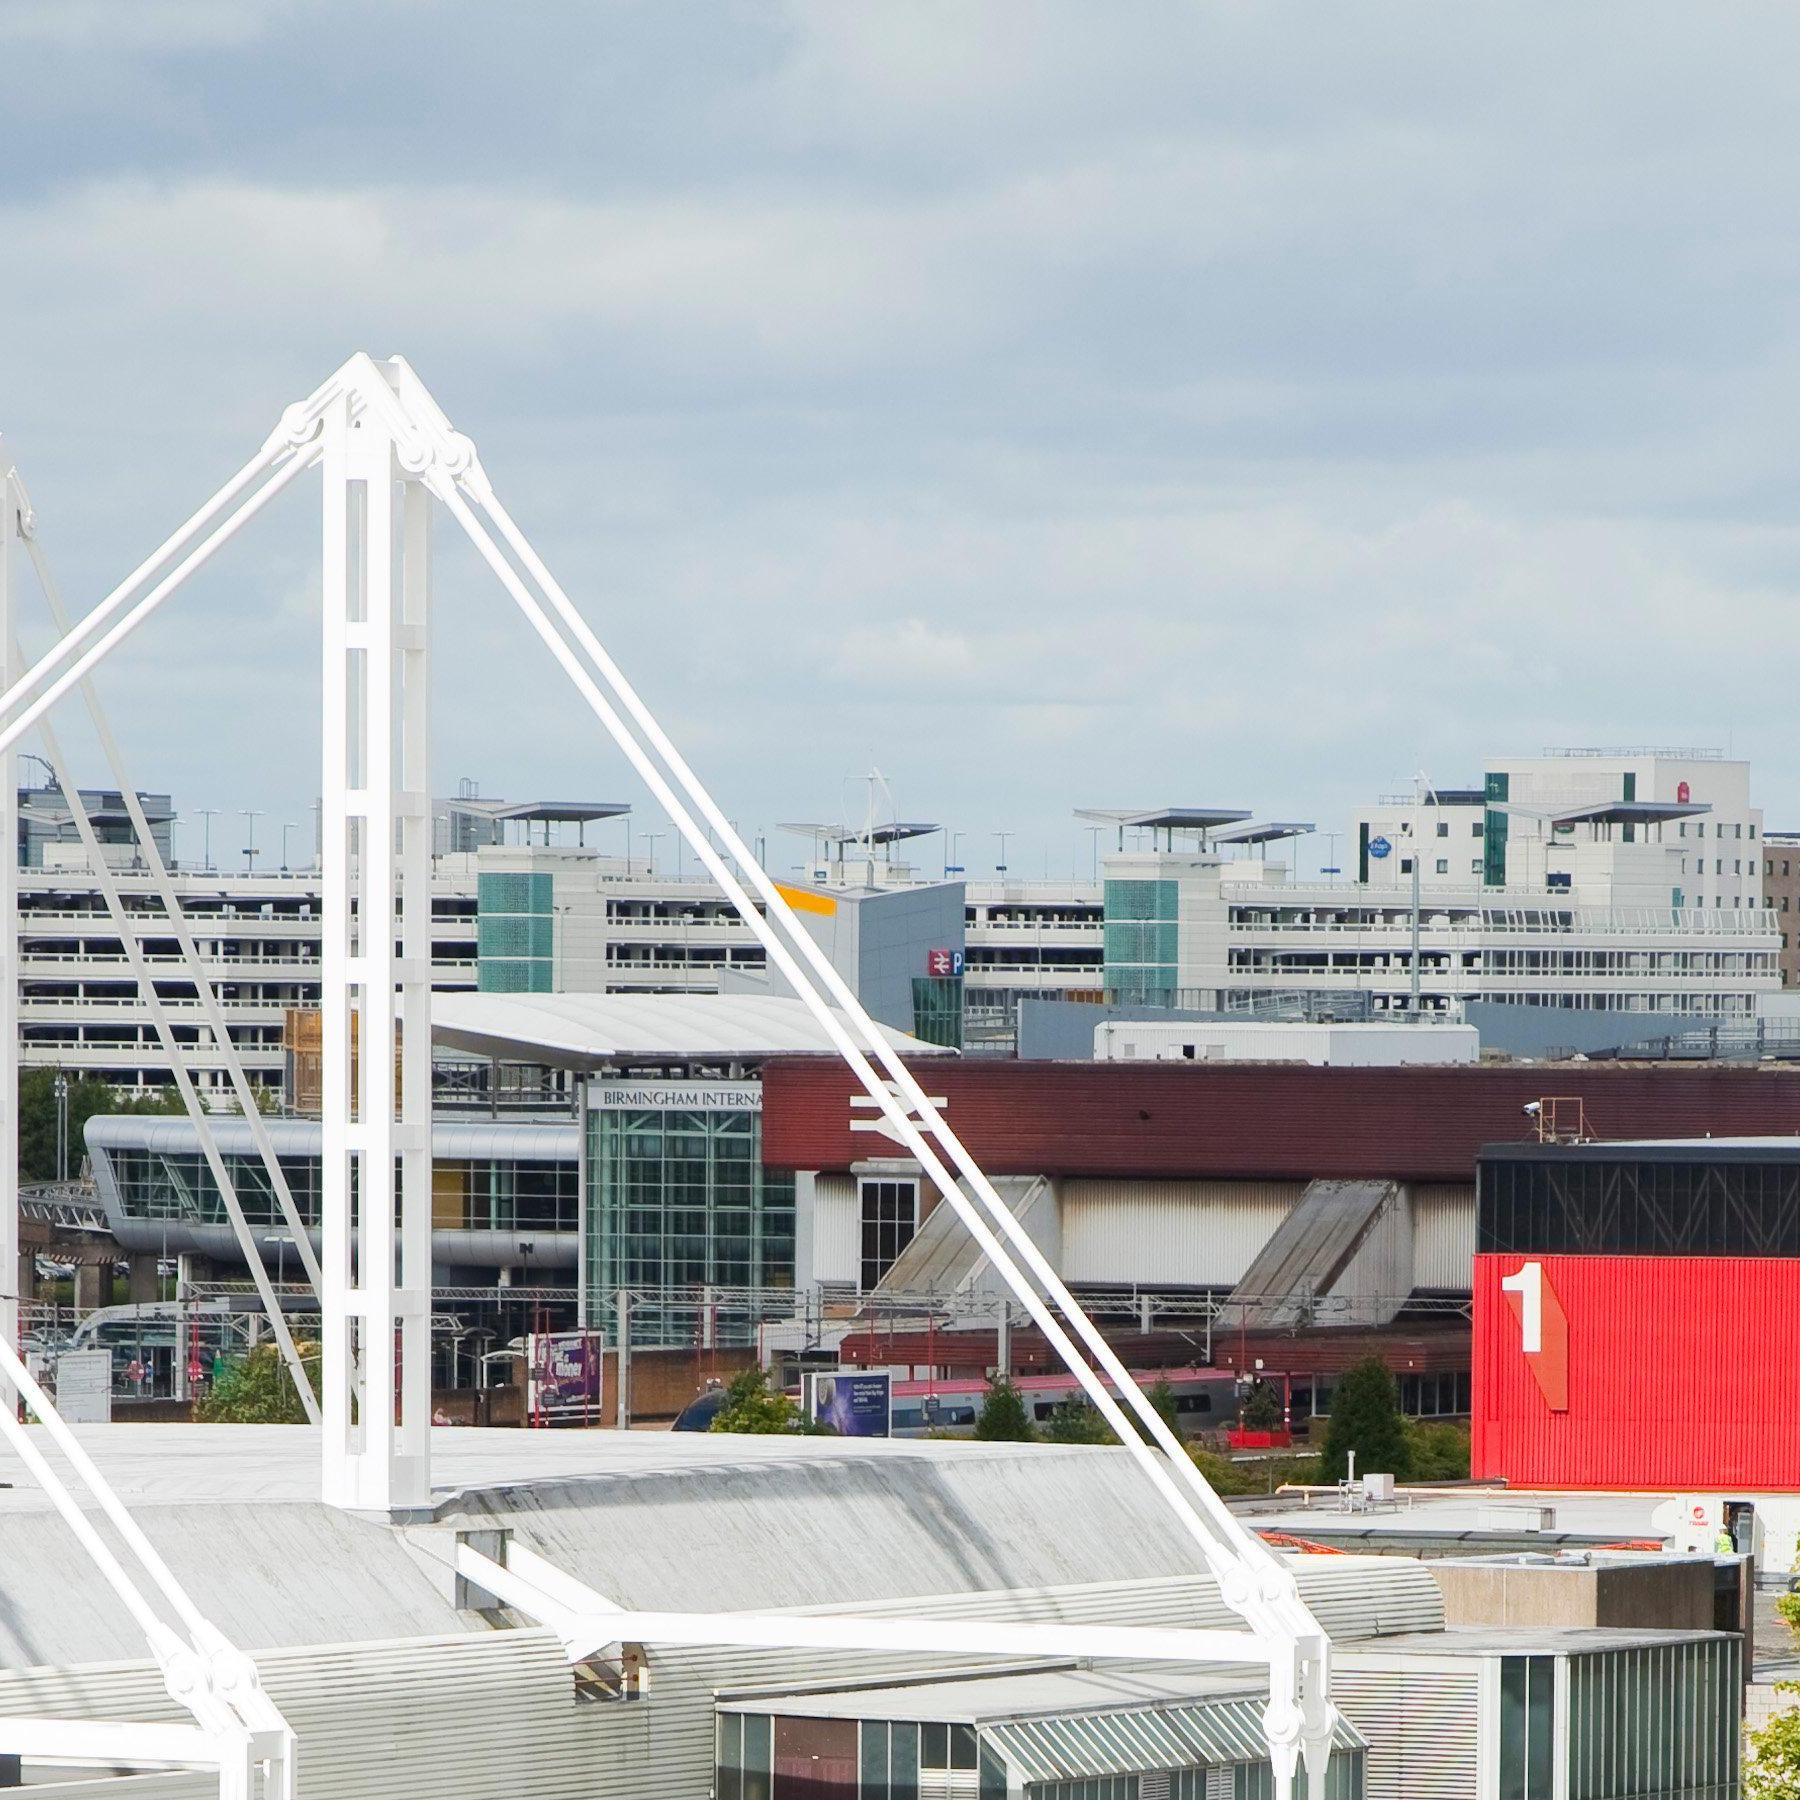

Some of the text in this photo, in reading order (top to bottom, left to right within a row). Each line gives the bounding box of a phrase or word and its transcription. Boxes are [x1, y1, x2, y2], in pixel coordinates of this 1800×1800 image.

[953, 952, 963, 975] P
[603, 1091, 699, 1106] BIRMINGHAM
[1501, 1262, 1542, 1353] 1
